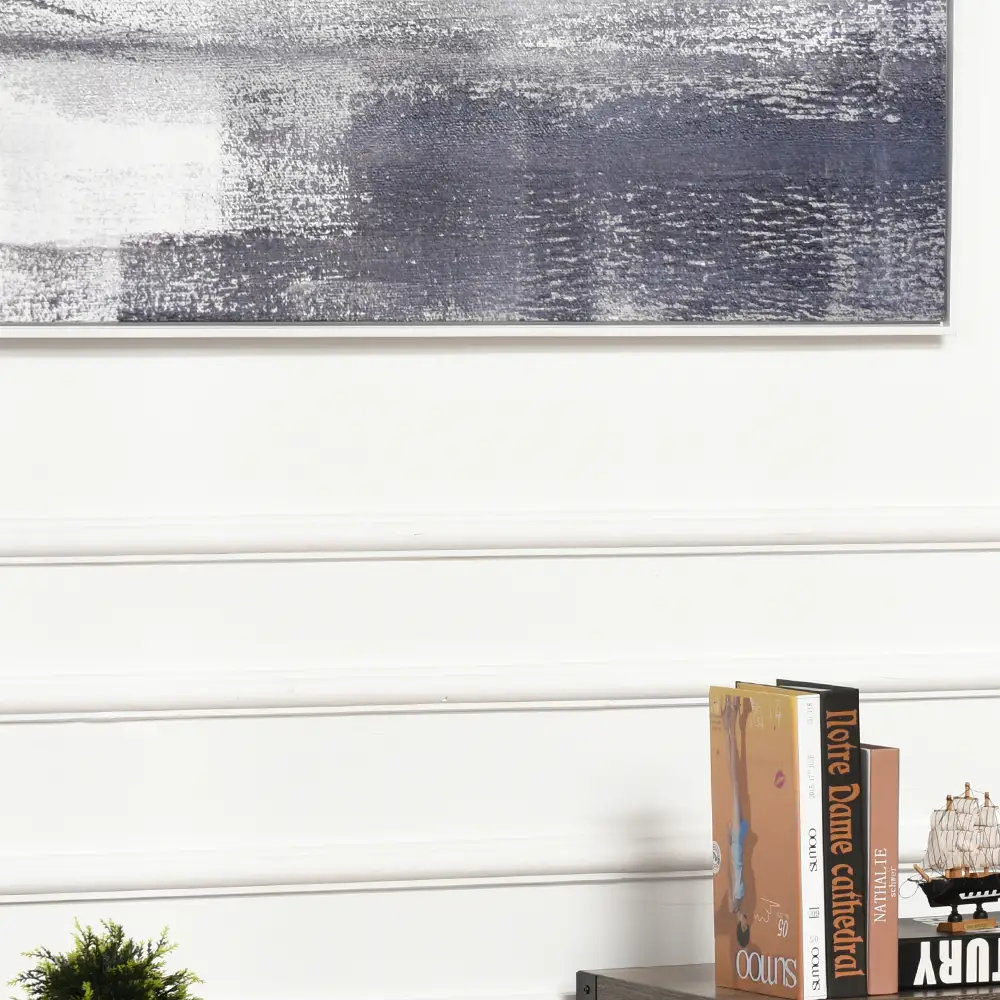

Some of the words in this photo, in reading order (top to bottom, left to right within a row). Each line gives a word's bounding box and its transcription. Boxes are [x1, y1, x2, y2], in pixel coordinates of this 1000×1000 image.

[826, 709, 858, 776] Notre
[828, 783, 861, 856] Dame
[831, 863, 865, 979] cathedral
[874, 847, 887, 923] NATHALIE
